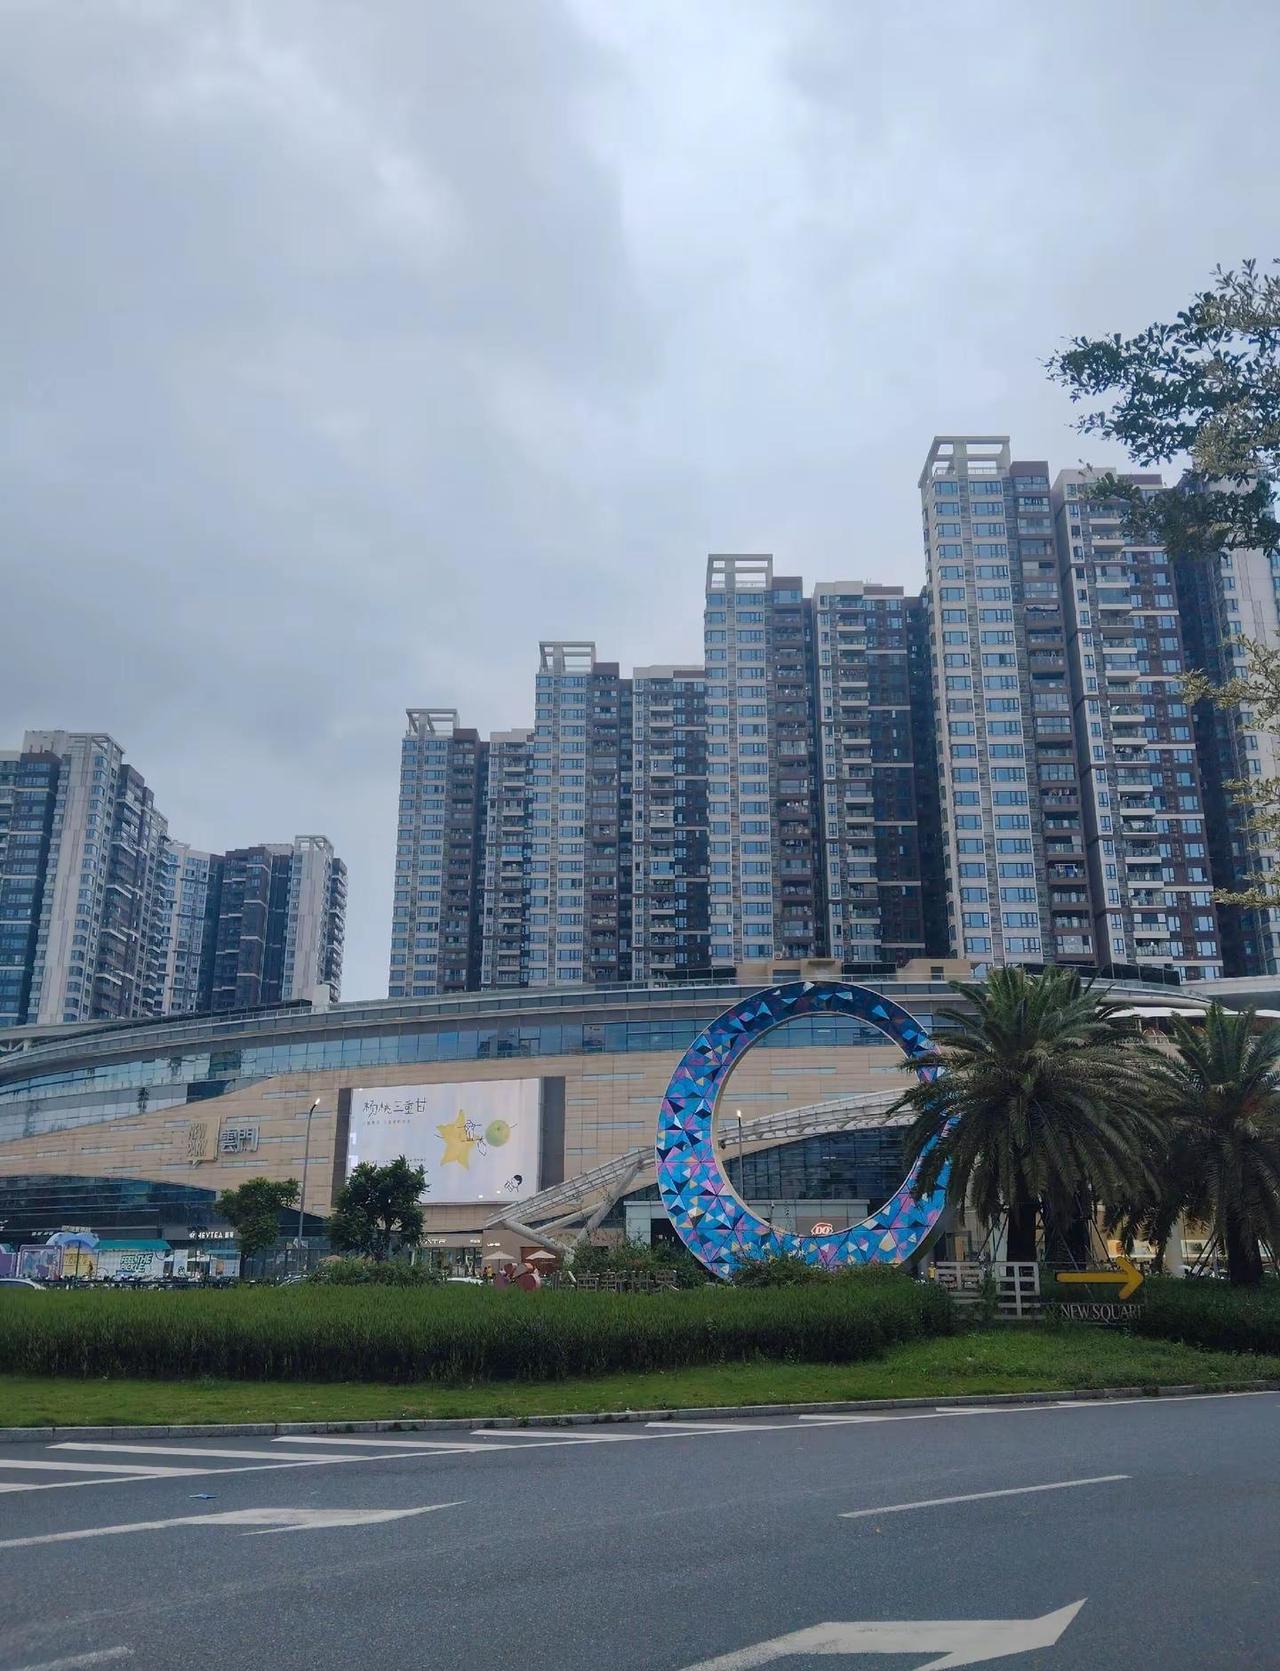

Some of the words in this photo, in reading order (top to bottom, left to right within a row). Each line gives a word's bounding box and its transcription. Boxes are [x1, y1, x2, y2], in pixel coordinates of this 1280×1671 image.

[221, 1128, 259, 1153] 雲門
[137, 1253, 153, 1264] THE
[1060, 1302, 1090, 1320] NEW
